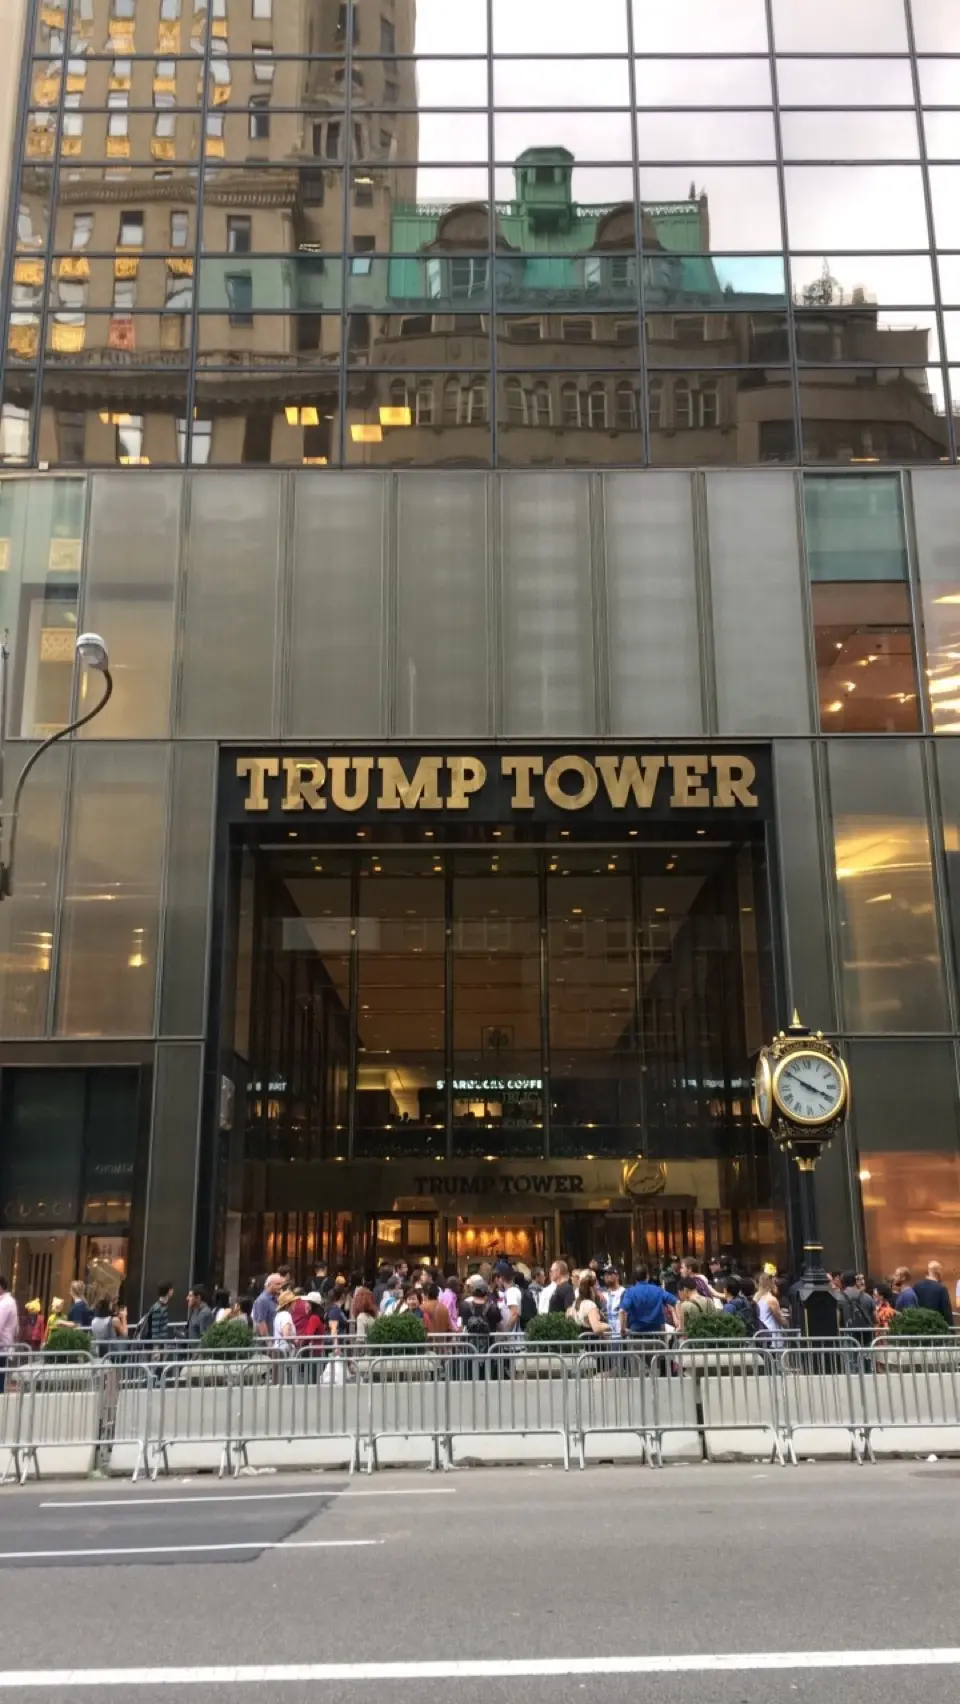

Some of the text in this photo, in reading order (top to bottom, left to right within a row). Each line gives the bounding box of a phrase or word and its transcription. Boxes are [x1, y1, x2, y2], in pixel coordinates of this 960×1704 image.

[236, 755, 758, 811] TRUMP TOWER
[437, 1080, 504, 1089] SARBUCKS
[413, 1175, 584, 1194] TRUMP TOWER
